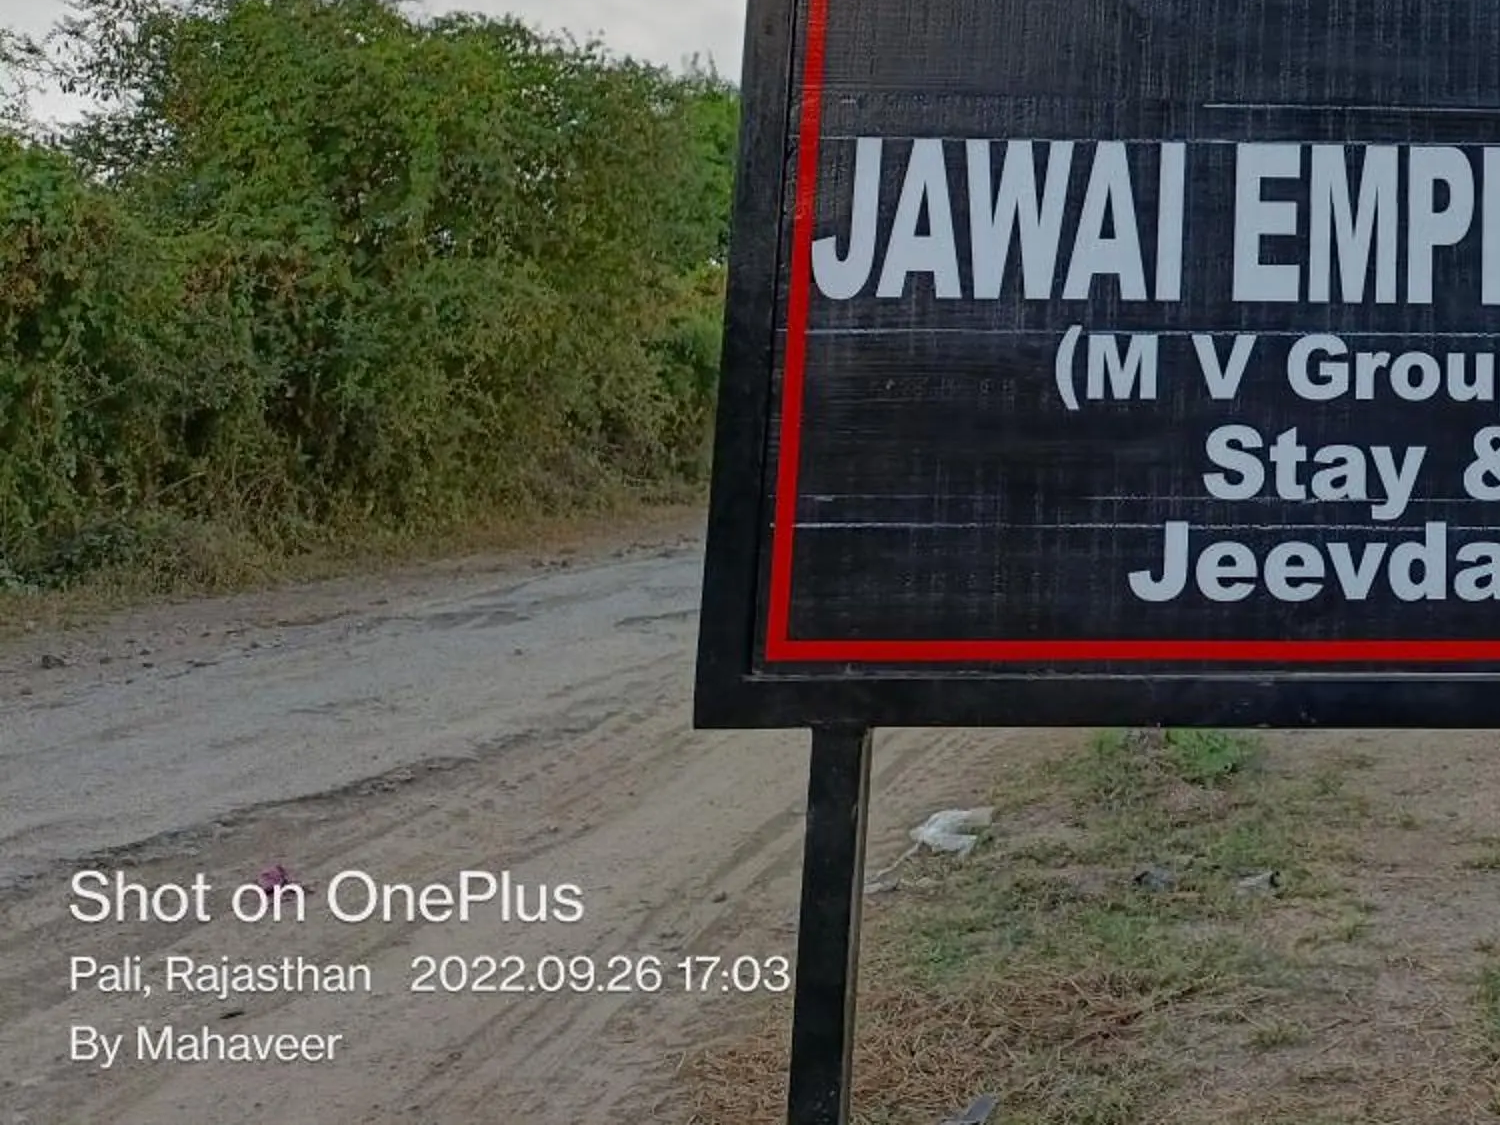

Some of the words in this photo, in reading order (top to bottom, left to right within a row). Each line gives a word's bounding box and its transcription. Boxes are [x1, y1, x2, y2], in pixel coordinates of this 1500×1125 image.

[811, 137, 1185, 301] JAWAI
[1056, 325, 1159, 411] (M
[1191, 334, 1258, 400] V
[1203, 425, 1426, 520] Stay
